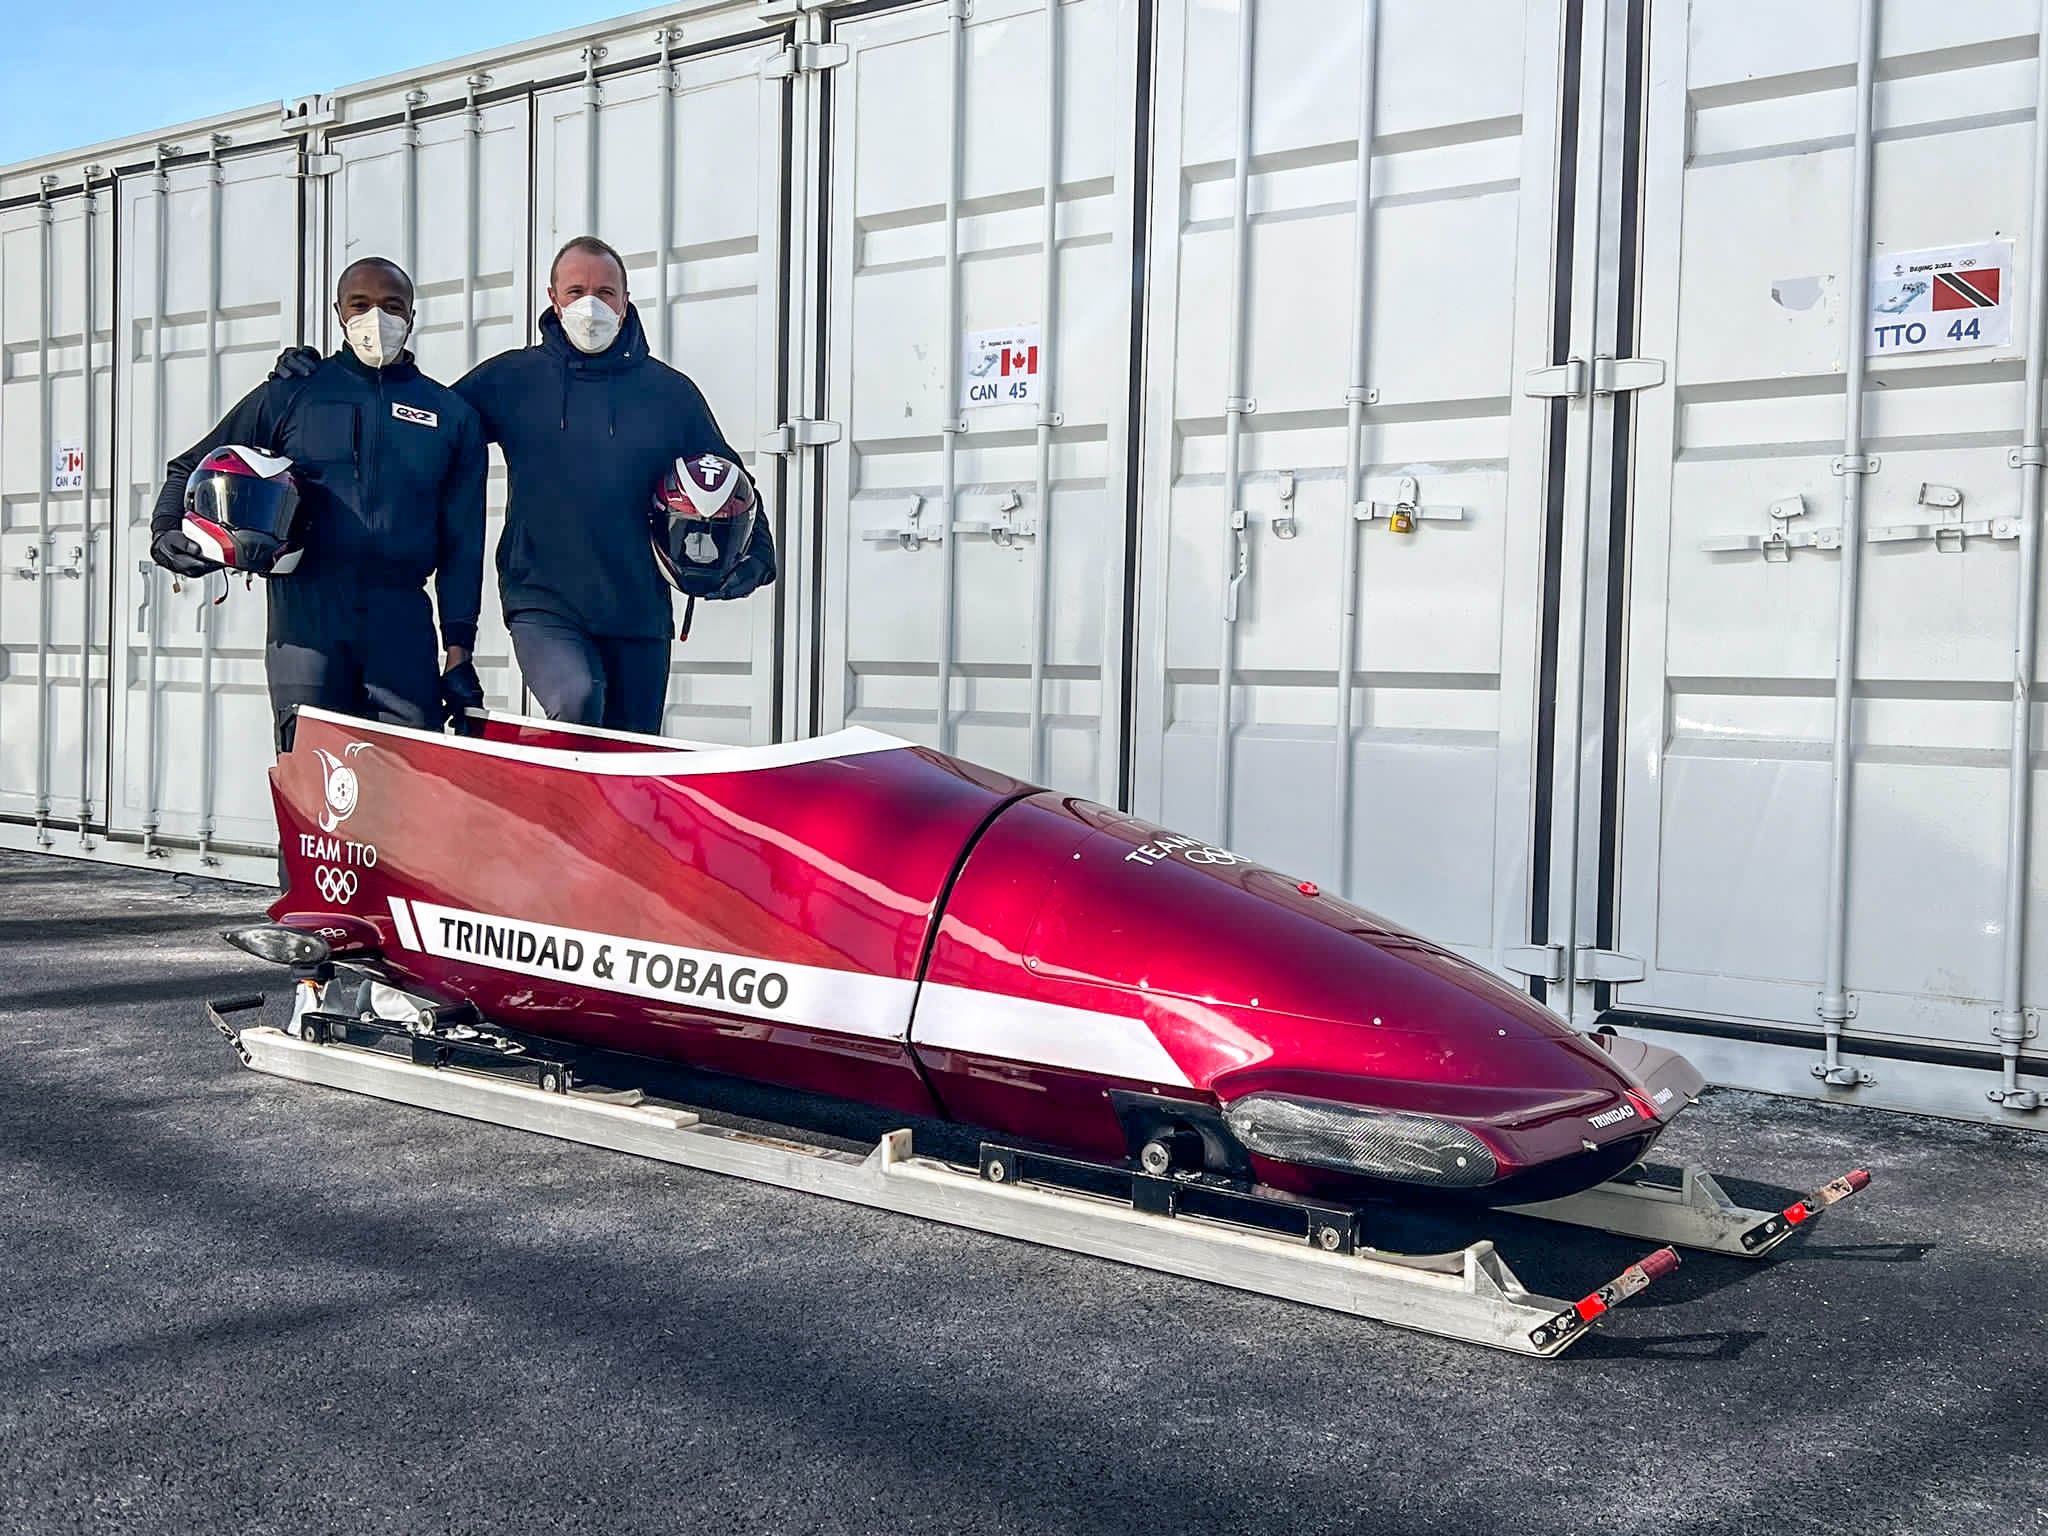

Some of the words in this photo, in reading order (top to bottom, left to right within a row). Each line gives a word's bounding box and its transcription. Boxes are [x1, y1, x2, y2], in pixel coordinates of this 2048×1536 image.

[1874, 322, 1927, 348] TTO
[1946, 317, 1981, 341] 44
[969, 383, 998, 401] CAN
[1008, 381, 1028, 399] 45
[55, 476, 69, 487] CAN
[72, 475, 82, 487] 47
[700, 467, 721, 486] T
[299, 833, 341, 863] TEAM
[345, 840, 378, 869] TTO
[438, 916, 584, 972] TRINIDAD
[592, 944, 616, 981] &
[625, 948, 790, 1010] TOBAGO
[1587, 1104, 1636, 1129] TRINIDAD
